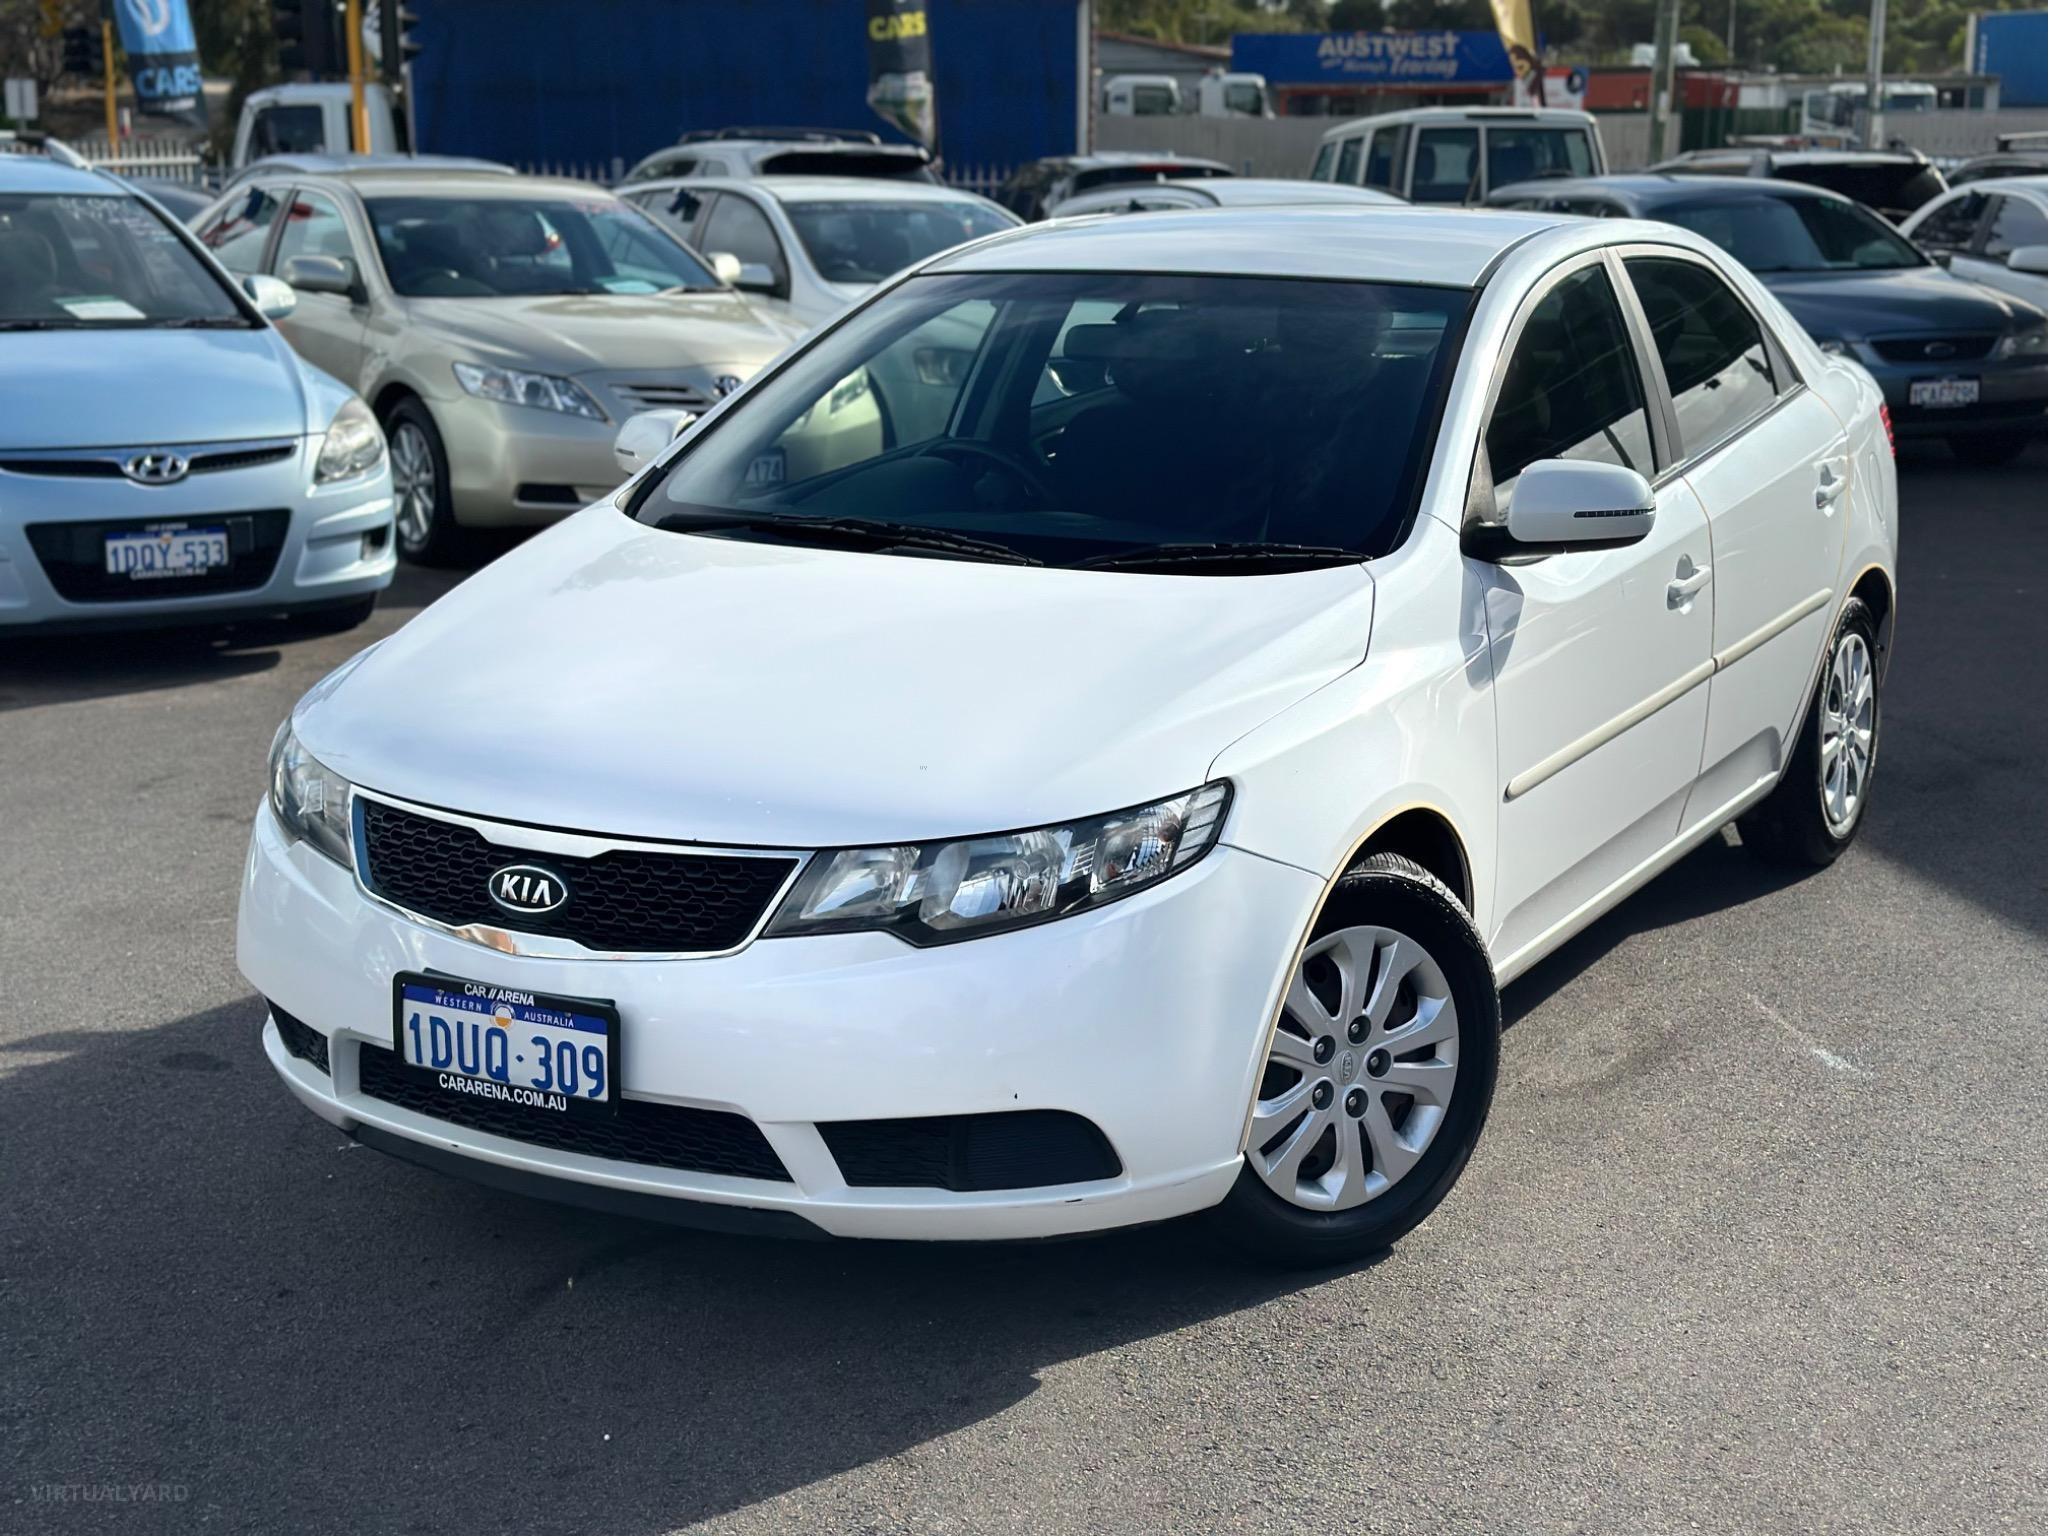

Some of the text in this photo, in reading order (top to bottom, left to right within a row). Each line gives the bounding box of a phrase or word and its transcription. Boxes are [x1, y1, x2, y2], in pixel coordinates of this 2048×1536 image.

[501, 873, 552, 906] KIA
[464, 983, 487, 997] CAR
[498, 989, 535, 1007] ARENA
[435, 996, 575, 1028] WESTERN AUSTRALIA
[438, 1073, 567, 1112] CARARENA.COM.AU
